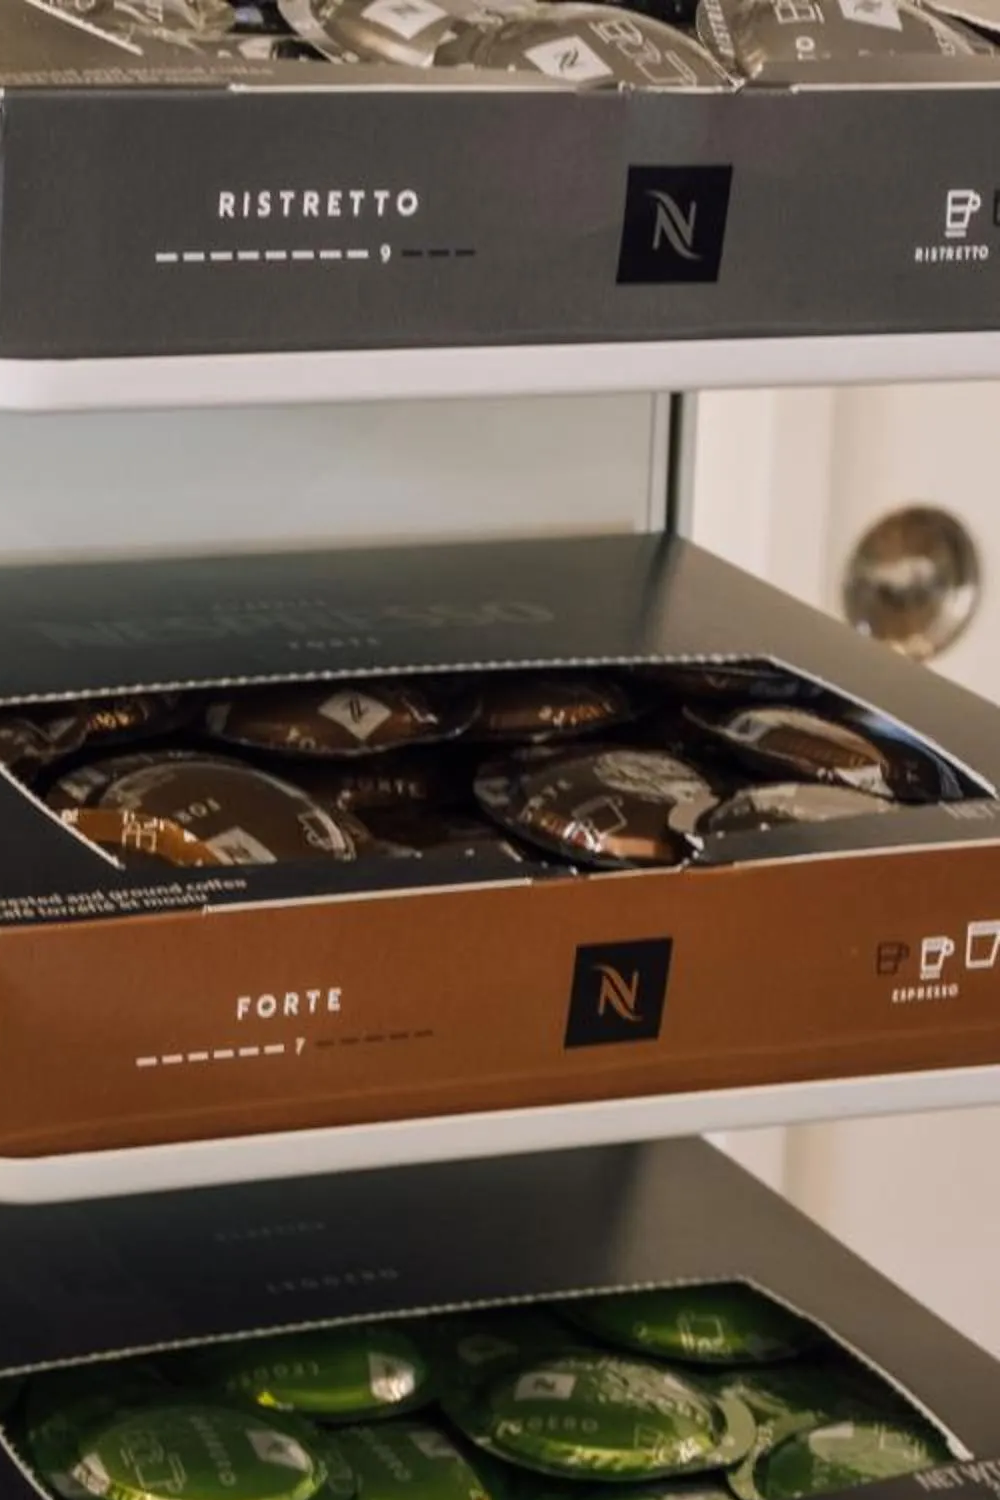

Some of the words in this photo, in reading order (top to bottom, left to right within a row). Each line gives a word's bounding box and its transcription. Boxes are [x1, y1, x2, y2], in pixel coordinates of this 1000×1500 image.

[218, 189, 419, 218] RISTRETTO
[913, 245, 989, 263] RISTRETTO
[236, 986, 342, 1021] FORTE
[891, 982, 959, 1004] ESPRESSO
